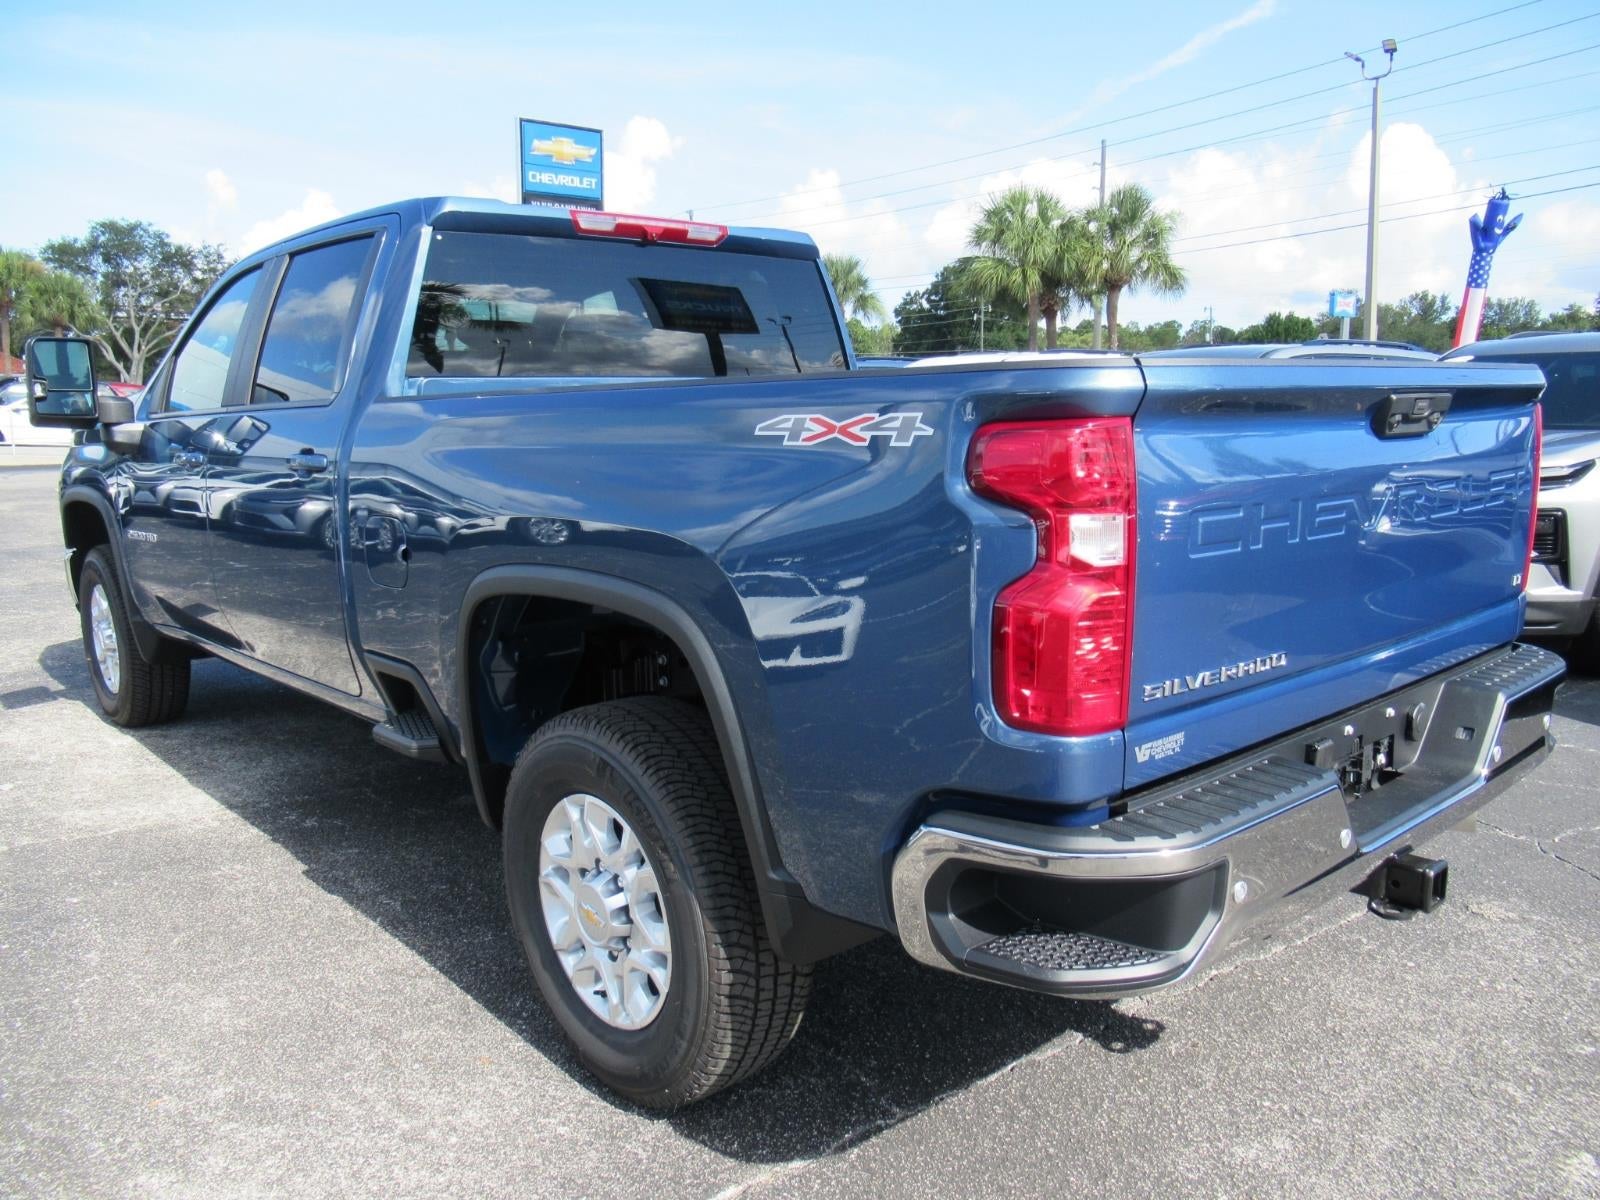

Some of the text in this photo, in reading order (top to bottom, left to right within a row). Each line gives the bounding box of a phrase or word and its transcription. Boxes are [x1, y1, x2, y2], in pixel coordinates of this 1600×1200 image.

[528, 171, 597, 189] CHEVROLET
[1188, 466, 1528, 560] CHEVROLET
[1142, 651, 1288, 702] SILVERADO
